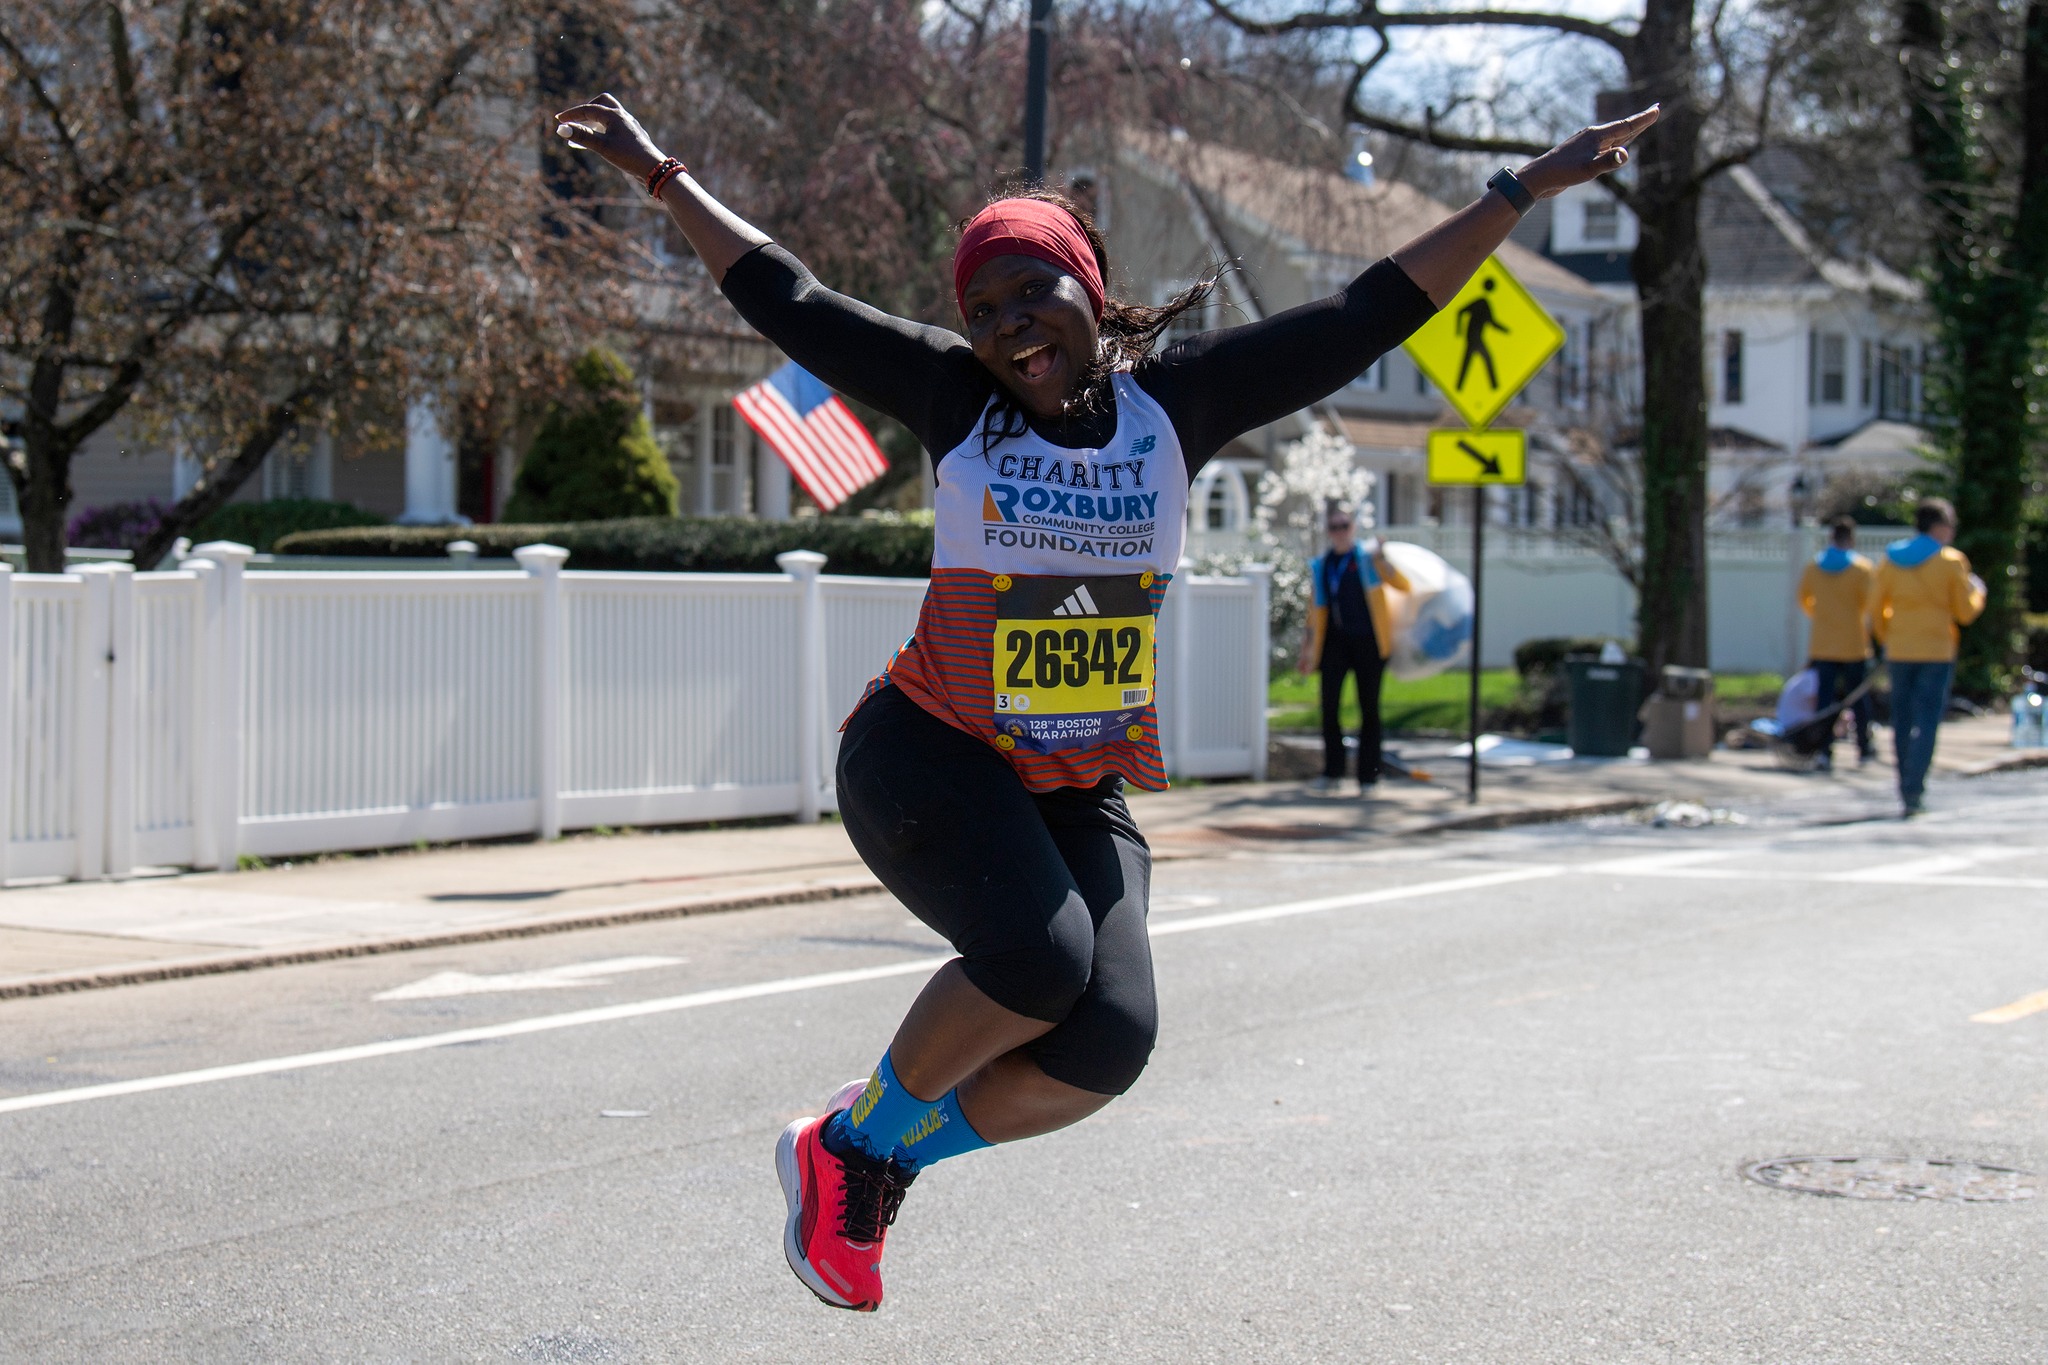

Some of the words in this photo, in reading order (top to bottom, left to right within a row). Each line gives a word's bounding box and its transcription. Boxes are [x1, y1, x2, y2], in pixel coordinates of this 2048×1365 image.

[999, 454, 1145, 490] CHARITY
[982, 483, 1159, 523] ROXBURY
[1022, 514, 1104, 535] COMMUNITY
[1108, 521, 1155, 535] COLLEGE
[984, 529, 1153, 557] FOUNDATION
[1006, 627, 1141, 688] 26342
[998, 695, 1008, 709] 3
[1031, 727, 1100, 740] MARATHON
[1057, 718, 1102, 729] BOSTON
